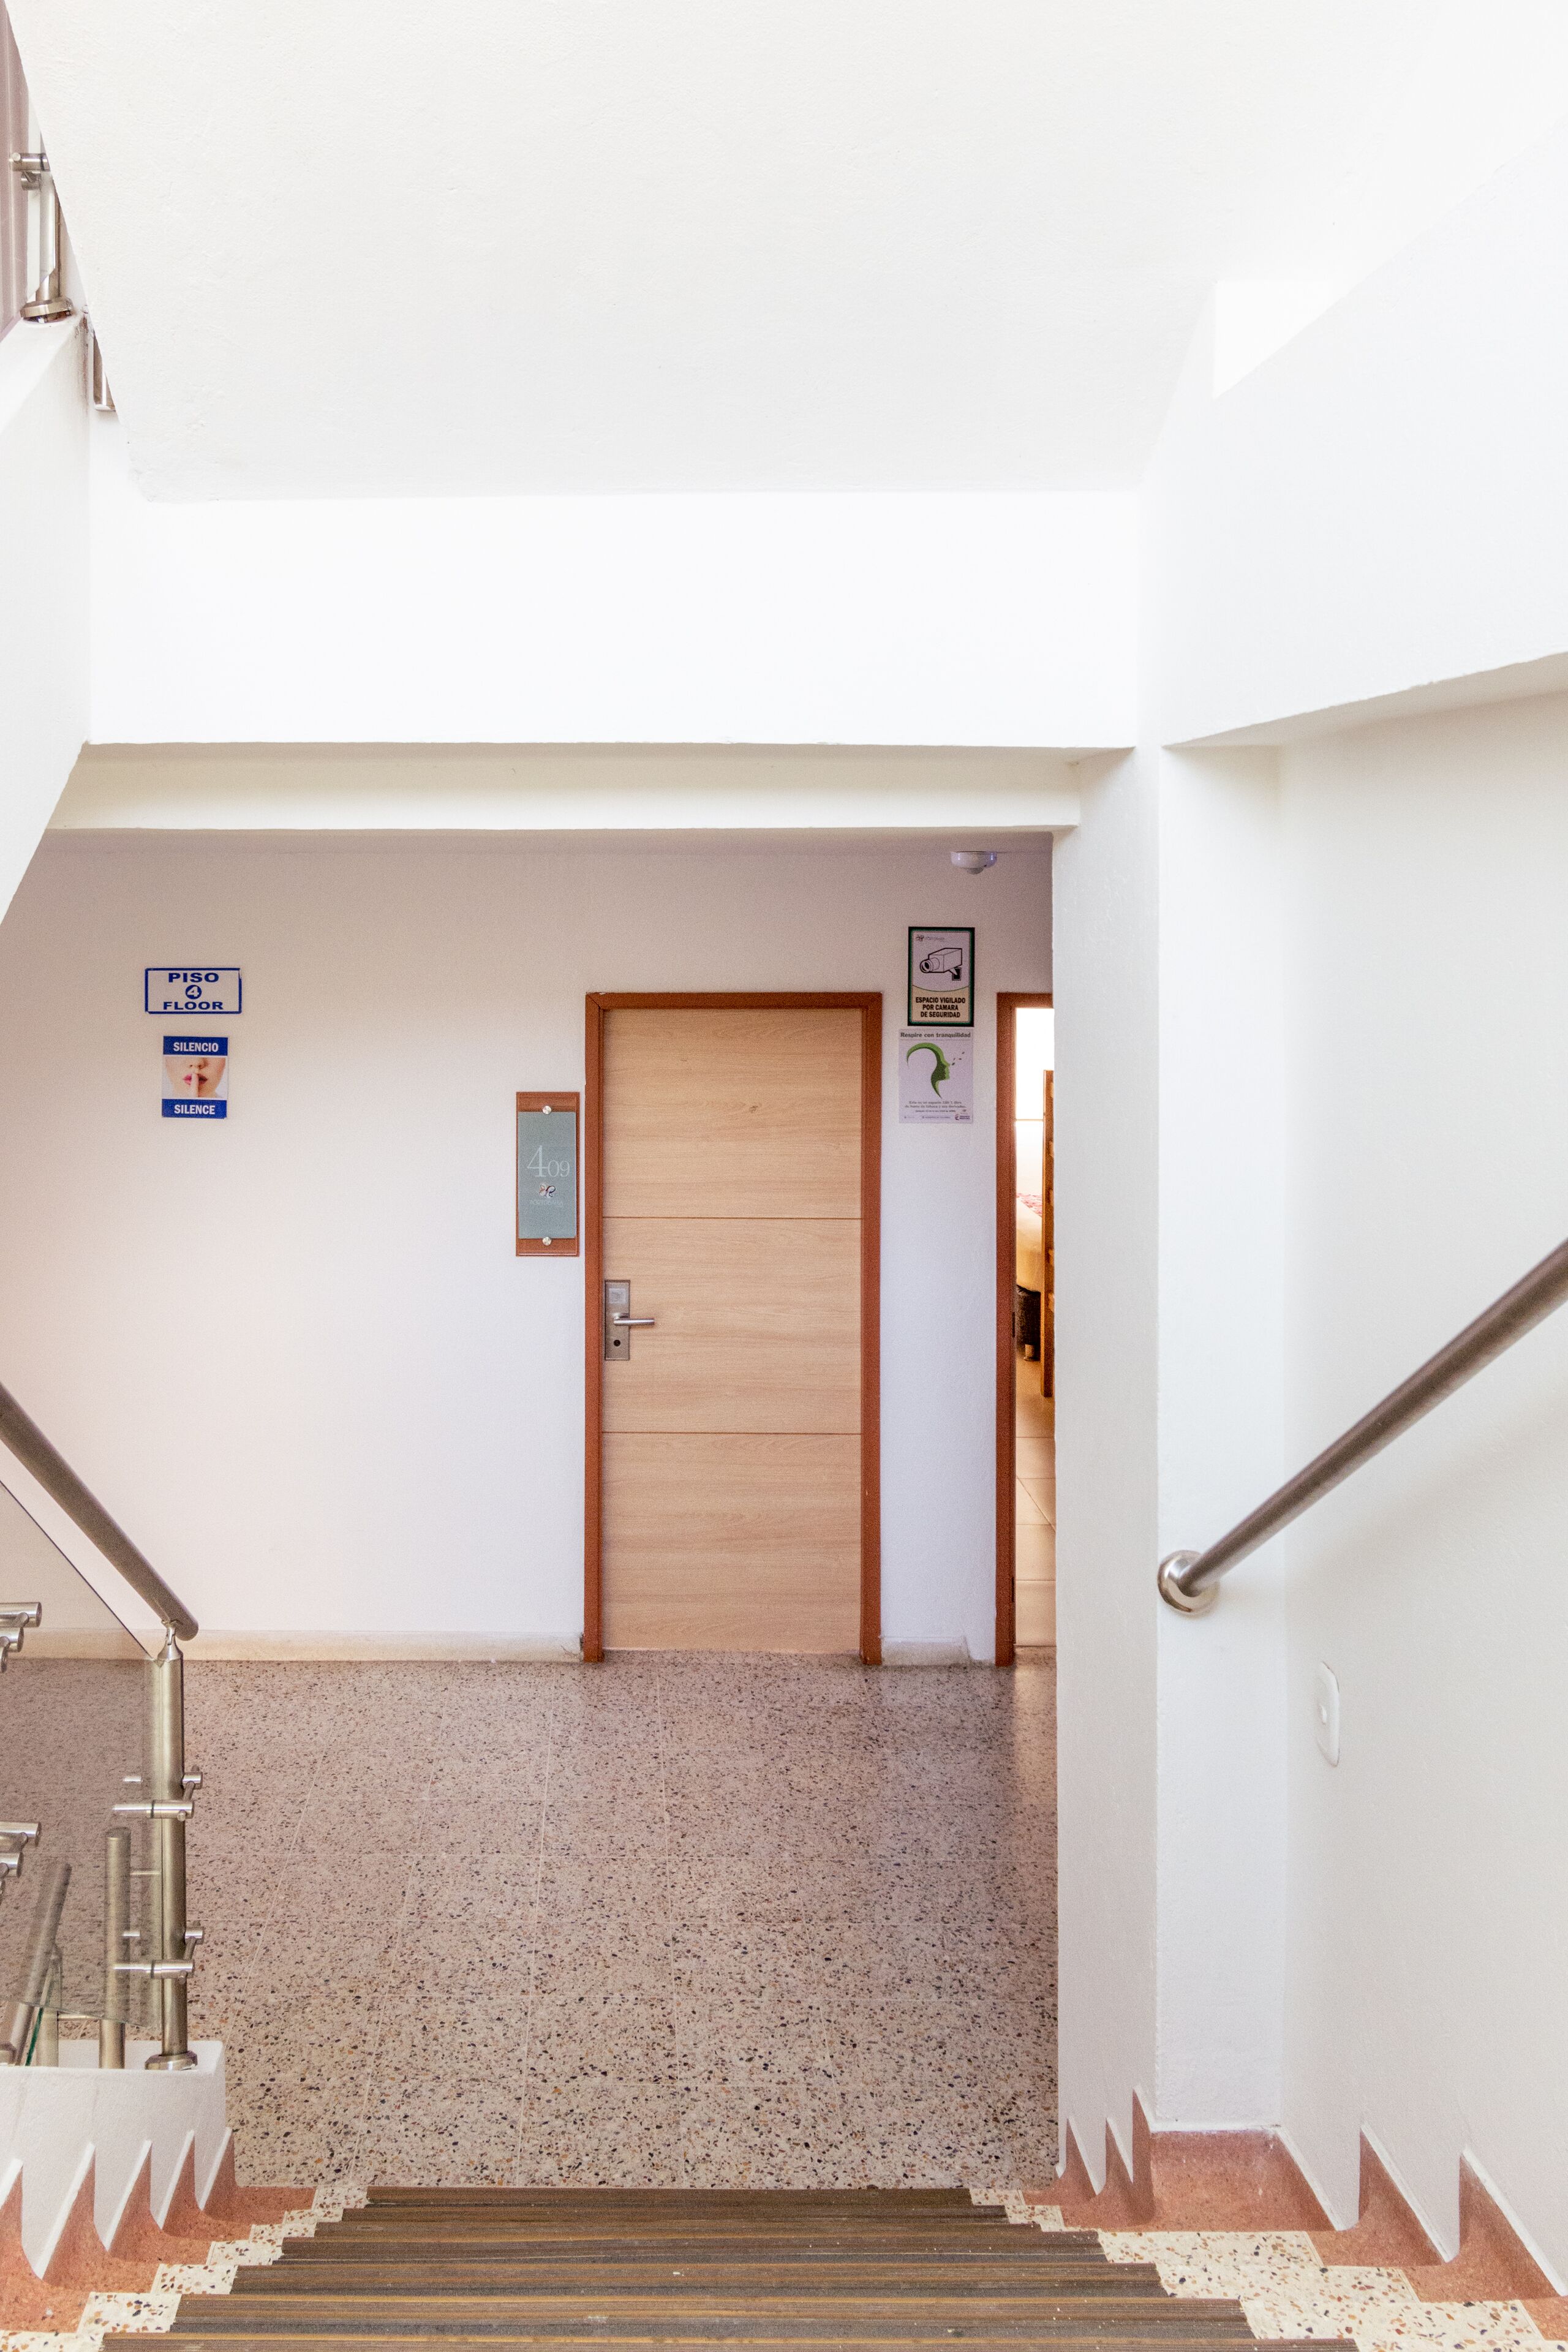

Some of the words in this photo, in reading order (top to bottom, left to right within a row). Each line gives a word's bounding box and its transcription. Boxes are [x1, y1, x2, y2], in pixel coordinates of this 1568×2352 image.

[168, 973, 219, 983] PISO
[187, 986, 200, 998] 4
[163, 1001, 224, 1010] FLOOR
[173, 1042, 219, 1052] SILENCIO
[174, 1104, 216, 1115] SILENCE
[527, 1145, 570, 1177] 409
